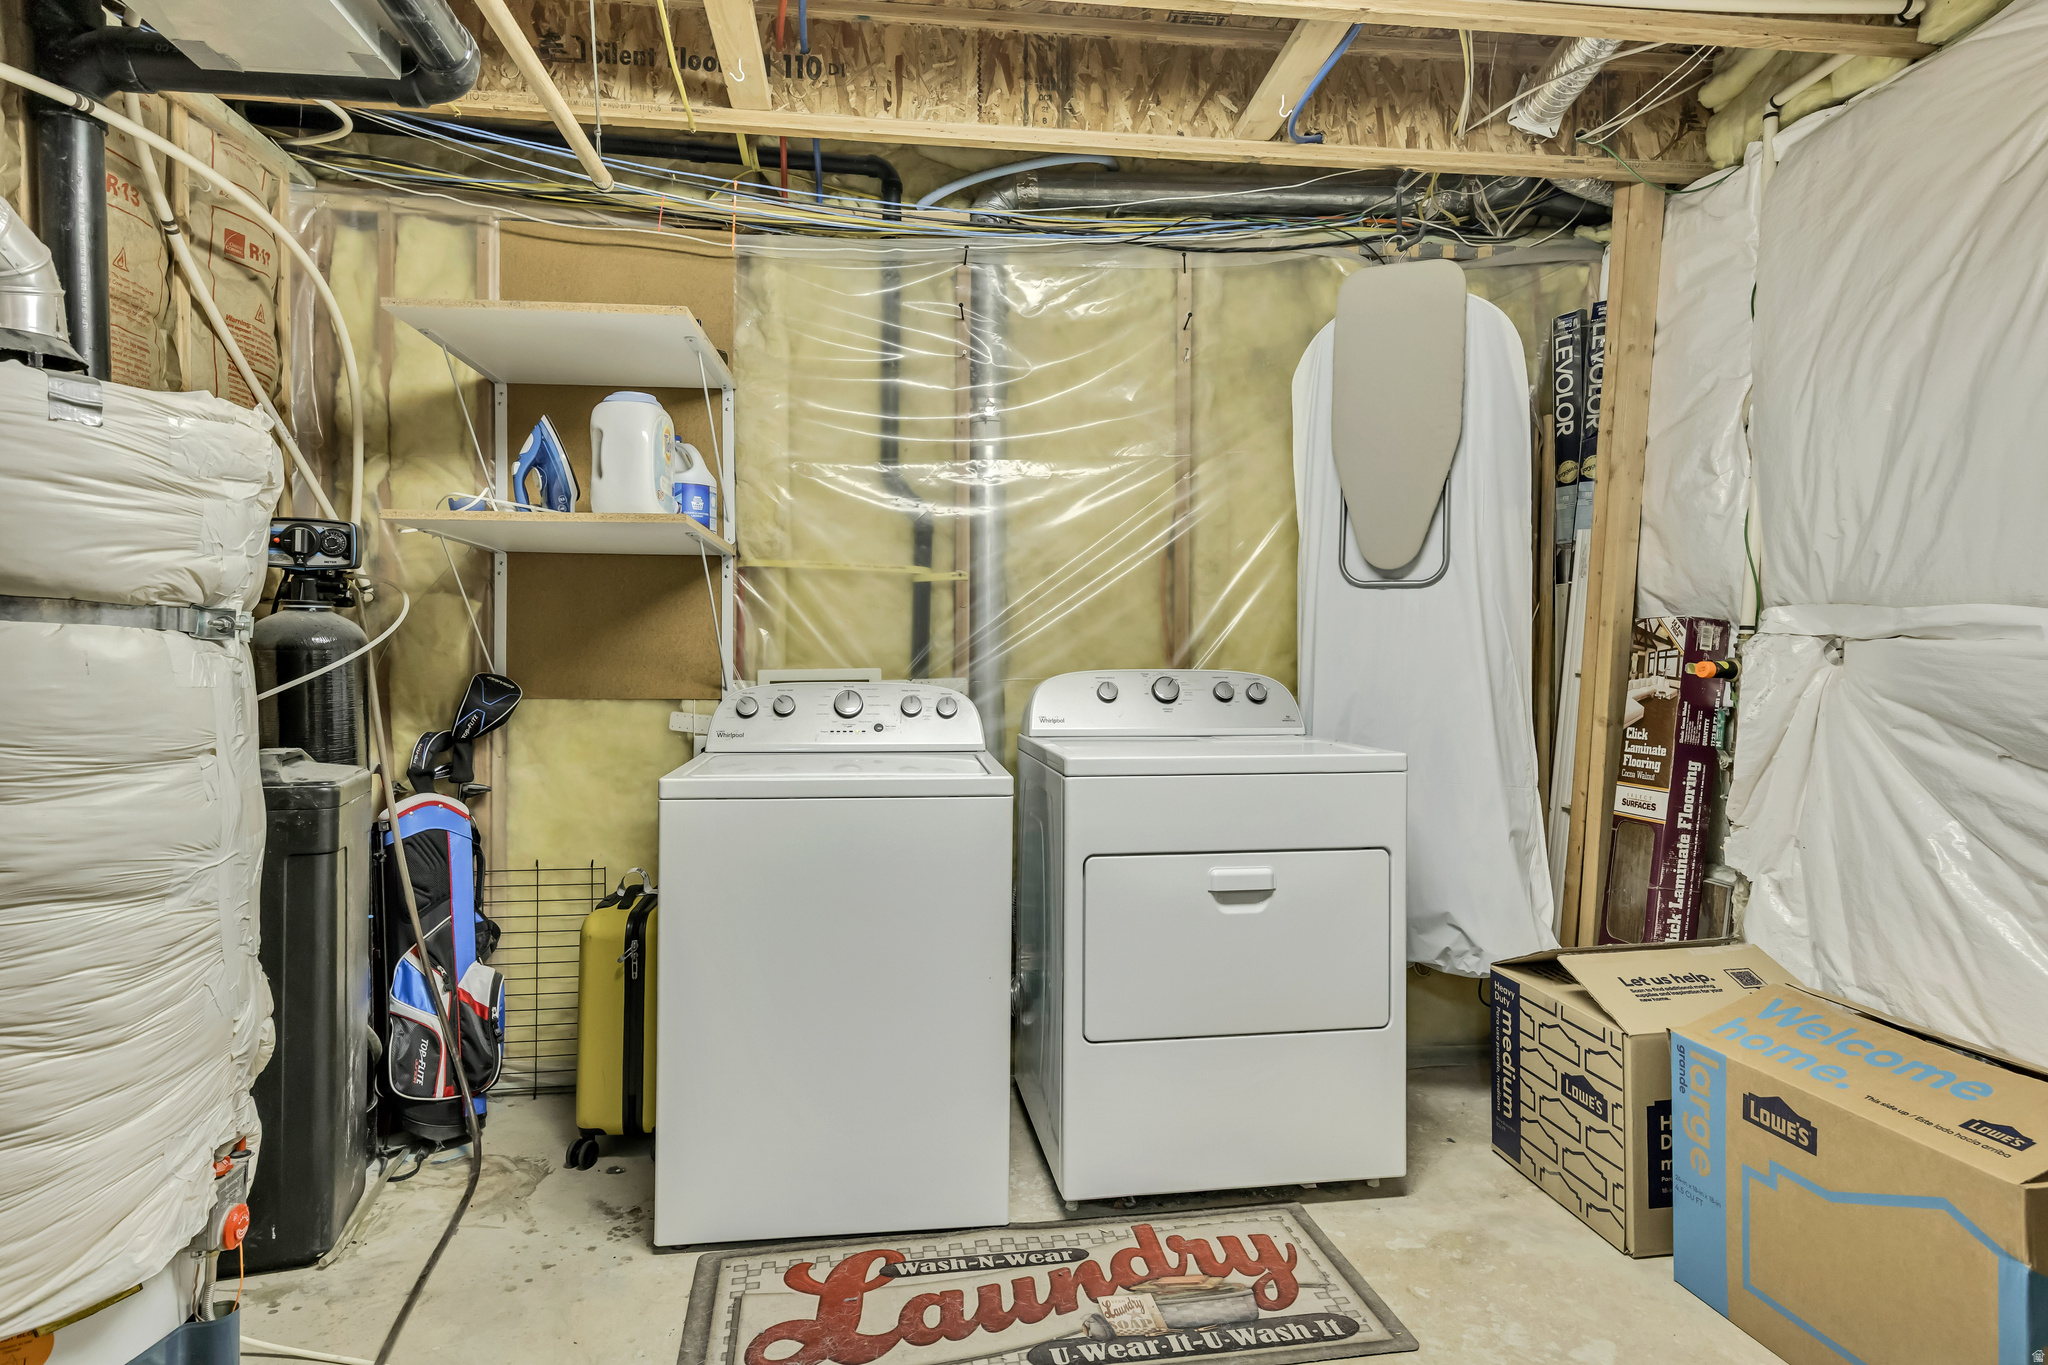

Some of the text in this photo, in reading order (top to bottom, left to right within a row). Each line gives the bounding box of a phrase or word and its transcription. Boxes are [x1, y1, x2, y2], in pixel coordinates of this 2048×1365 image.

[591, 42, 654, 67] Silent
[783, 54, 822, 81] 110
[105, 172, 141, 208] R-13
[1555, 334, 1575, 437] LEVOLOR
[1039, 717, 1066, 725] Whirlpool
[1626, 726, 1649, 741] Click
[716, 731, 745, 740] Whirlpool
[1624, 740, 1667, 757] Laminate
[1621, 769, 1656, 781] Cocoa Walnut
[1622, 754, 1662, 774] Flooring
[1621, 798, 1657, 811] SURFACES
[1677, 760, 1702, 830] Flooring
[1668, 834, 1691, 913] Laminate
[1664, 911, 1682, 943] lick
[1494, 980, 1516, 1001] Heavy
[1617, 972, 1716, 987] Let us help.
[1494, 991, 1511, 1009] Duty
[1710, 1017, 1850, 1090] home.
[1757, 998, 1994, 1101] Welcome
[1502, 1009, 1516, 1119] medium
[1676, 1044, 1688, 1094] grande
[1565, 1078, 1604, 1115] LOWE'S
[1682, 1050, 1720, 1178] large
[1750, 1099, 1809, 1147] LOWE'S
[1864, 1094, 1880, 1105] This
[1880, 1102, 1898, 1112] side
[1897, 1108, 1910, 1117] up
[1914, 1115, 1934, 1127] Este
[1933, 1124, 1954, 1136] lado
[1953, 1132, 1981, 1147] hacia
[1980, 1143, 2012, 1159] arriba
[1968, 1122, 2027, 1148] LOWE'S
[1675, 1184, 1684, 1195] 4.5
[1685, 1190, 1695, 1202] CU
[1695, 1196, 1704, 1207] FT
[894, 1249, 1073, 1276] Wash-N-Wear
[743, 1223, 1297, 1365] Laundry
[1102, 1296, 1146, 1319] Laundry
[1109, 1318, 1153, 1330] SOAP
